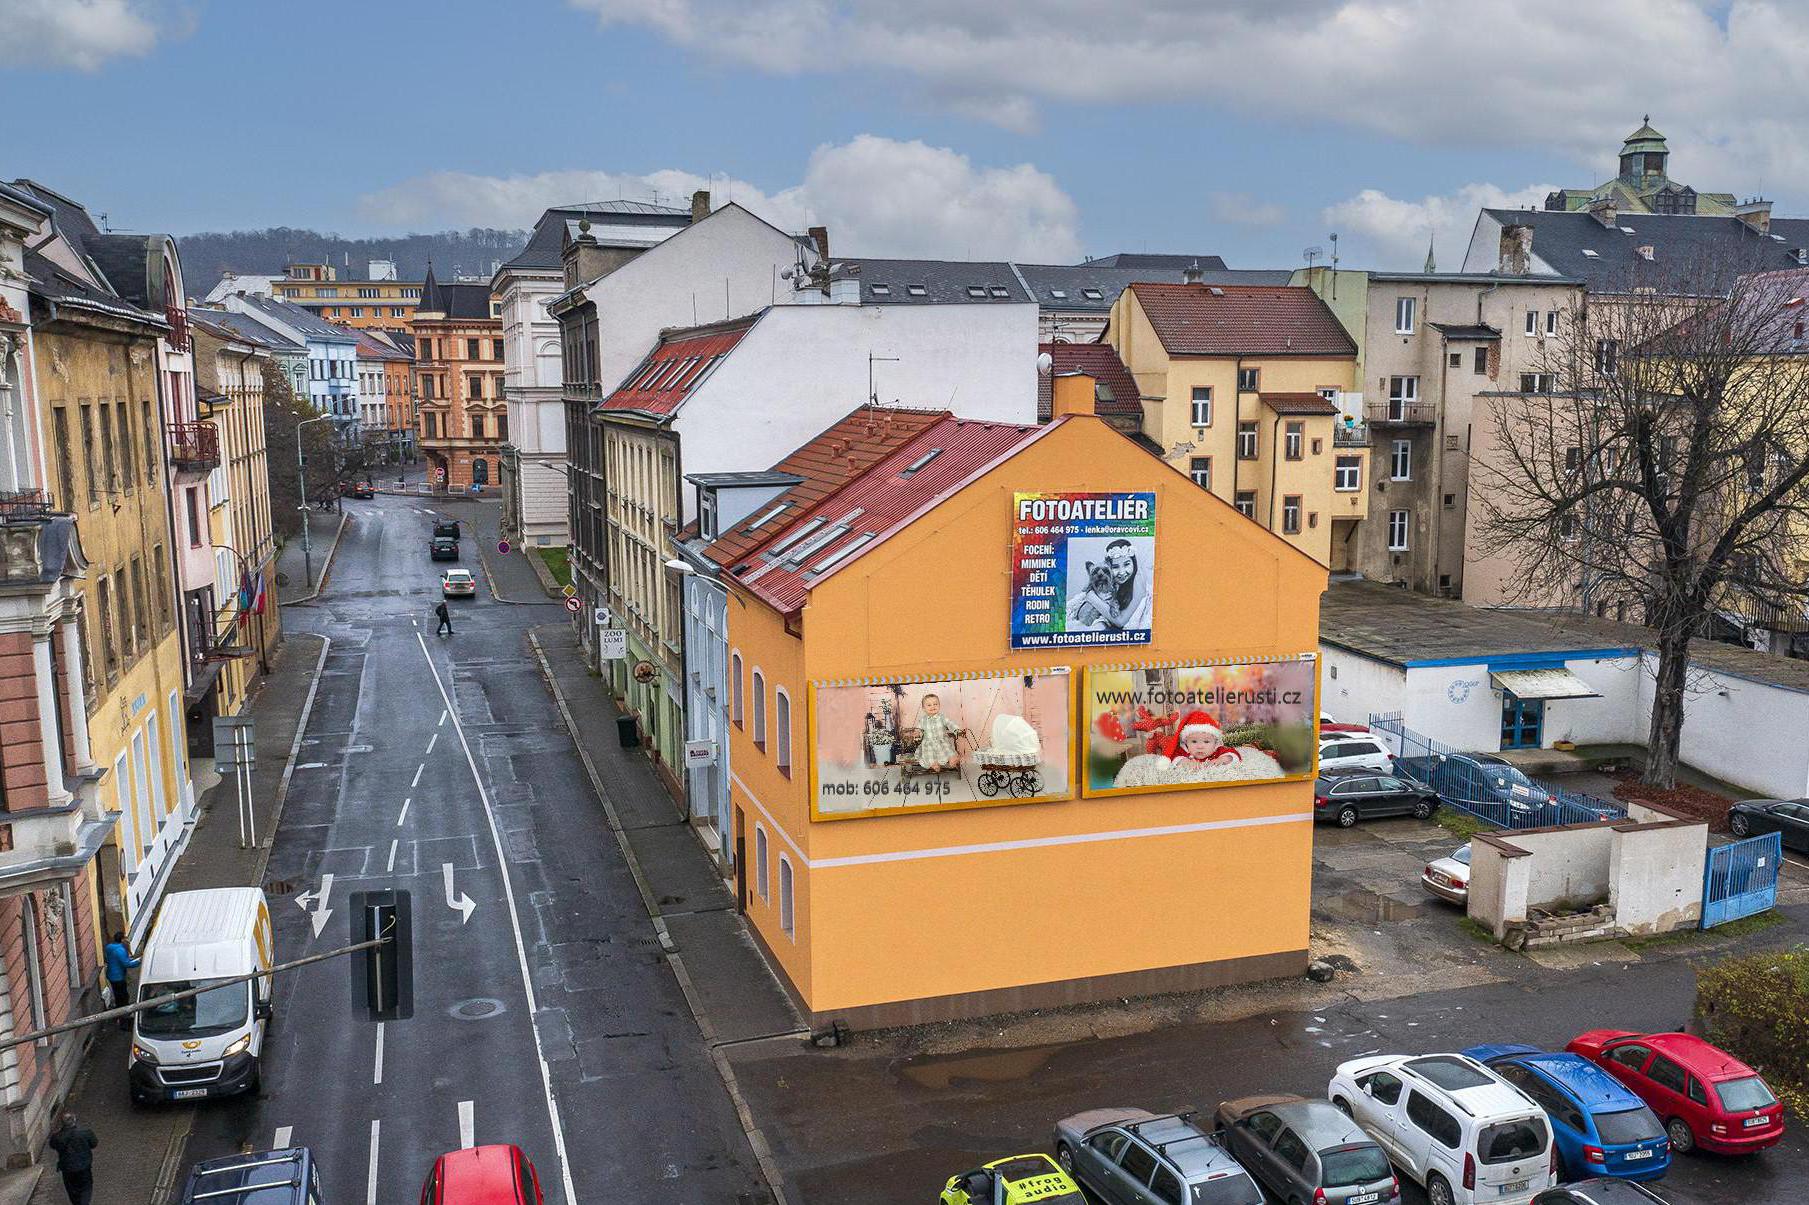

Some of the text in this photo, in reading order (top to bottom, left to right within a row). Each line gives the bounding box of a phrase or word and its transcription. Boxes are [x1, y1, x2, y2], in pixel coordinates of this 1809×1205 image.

[1019, 494, 1149, 520] FOTOATELIÉR
[1018, 526, 1033, 535] tel.:
[1035, 526, 1049, 534] 606
[1050, 526, 1064, 534] 464
[1066, 525, 1079, 534] 975
[1085, 525, 1149, 534] lenka@oravcovi.cz
[1023, 542, 1055, 555] FOCENÍ:
[1021, 558, 1057, 569] MIMINEK
[1029, 569, 1048, 583] DĚTÍ
[1021, 583, 1056, 597] TĚHULEK
[1025, 599, 1050, 611] RODIN
[1024, 613, 1051, 624] RETRO
[1021, 631, 1146, 646] www.fotoatelierusti.cz
[1096, 686, 1302, 705] www.fotoatelierusti.cz
[822, 779, 951, 796] mob: 606 464 975
[1019, 1177, 1062, 1190] #frog
[1025, 1184, 1067, 1197] audio
